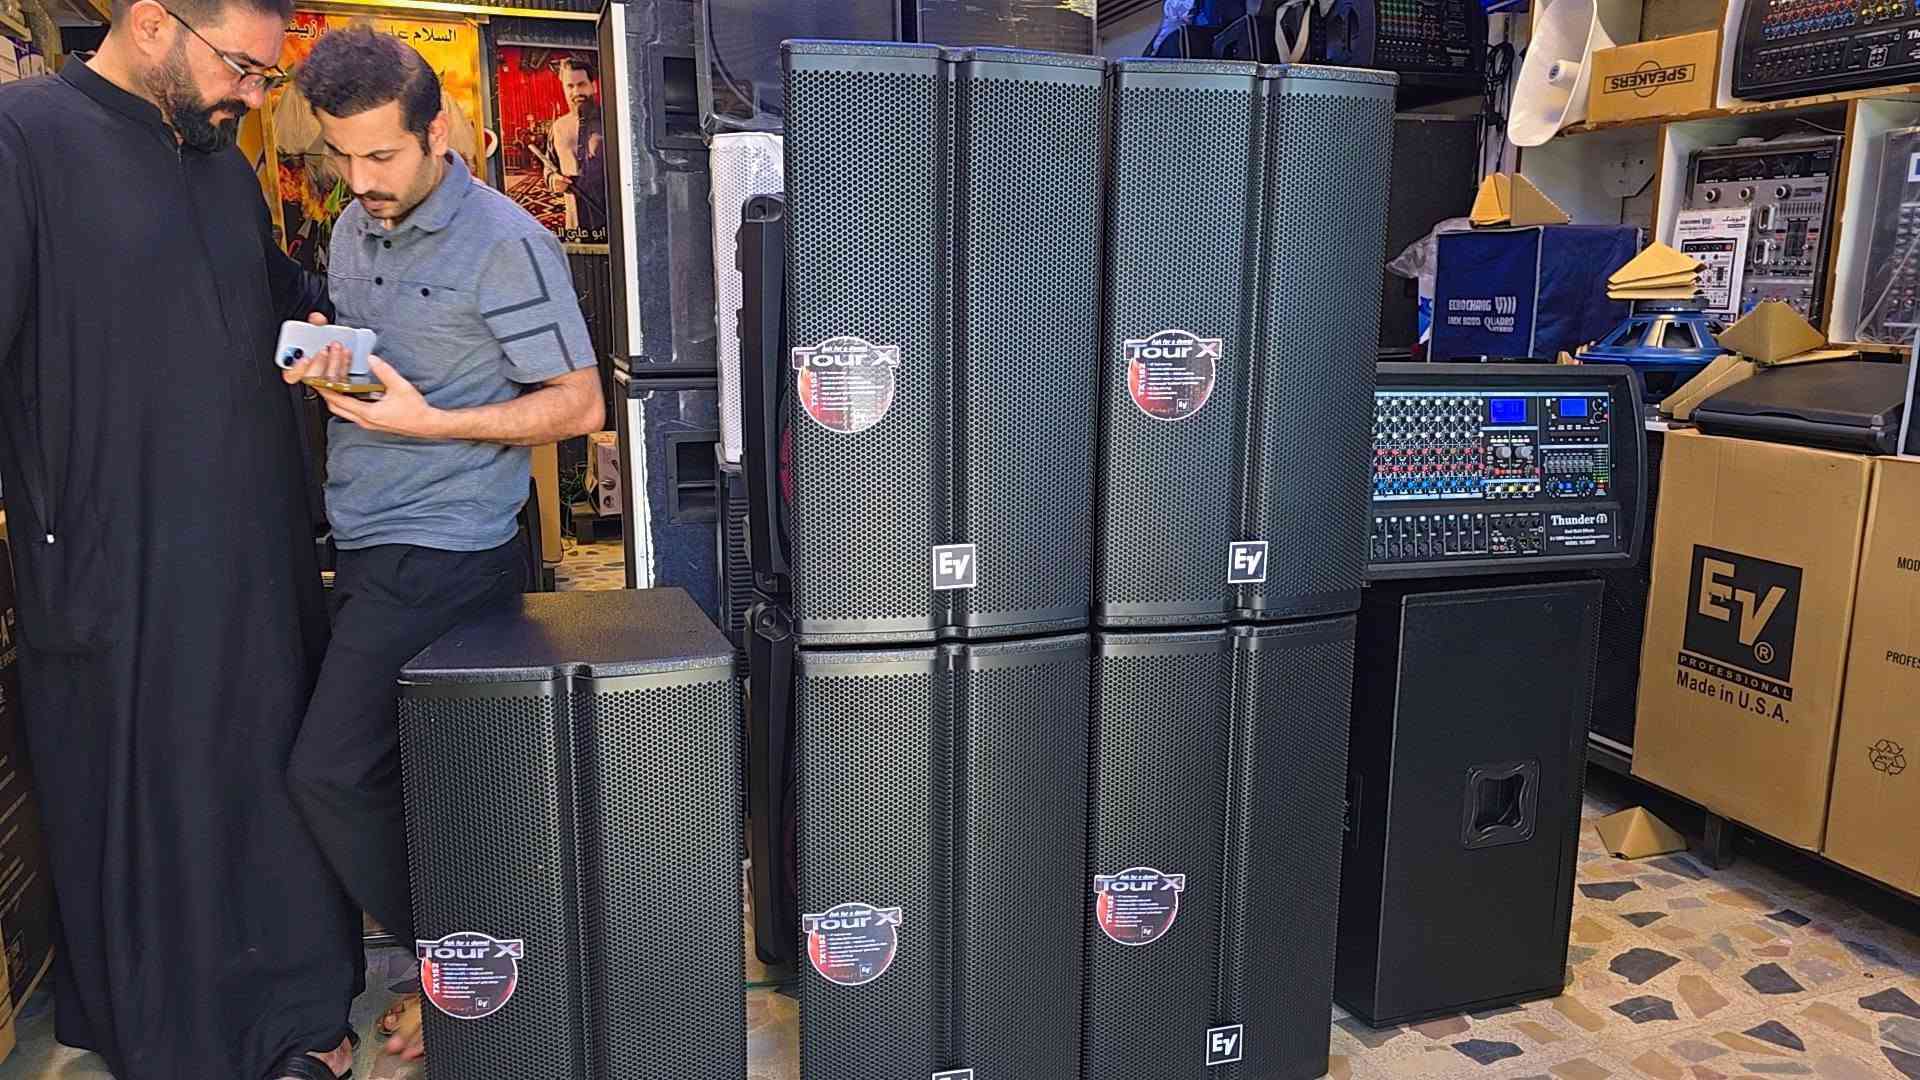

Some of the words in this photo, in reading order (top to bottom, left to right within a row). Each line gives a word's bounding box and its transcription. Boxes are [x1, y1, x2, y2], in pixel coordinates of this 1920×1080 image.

[413, 27, 456, 47] السلام
[1611, 67, 1688, 89] SPEAKERS
[794, 351, 868, 368] Tour
[1127, 344, 1193, 358] Tour
[1195, 342, 1219, 358] X
[1550, 513, 1596, 526] Thunder
[939, 551, 970, 580] EV
[1234, 547, 1263, 575] EV
[1698, 556, 1788, 647] EV
[1679, 655, 1792, 699] PROFESSIONAL
[1676, 669, 1716, 697] Made
[1719, 683, 1734, 705] in
[1738, 690, 1790, 725] U.S.A.
[1096, 878, 1159, 891] Tour
[1160, 877, 1181, 891] X
[805, 917, 872, 931] Tour
[874, 911, 899, 926] X
[419, 944, 490, 959] Tour
[493, 943, 521, 958] X
[1212, 1033, 1238, 1056] EV
